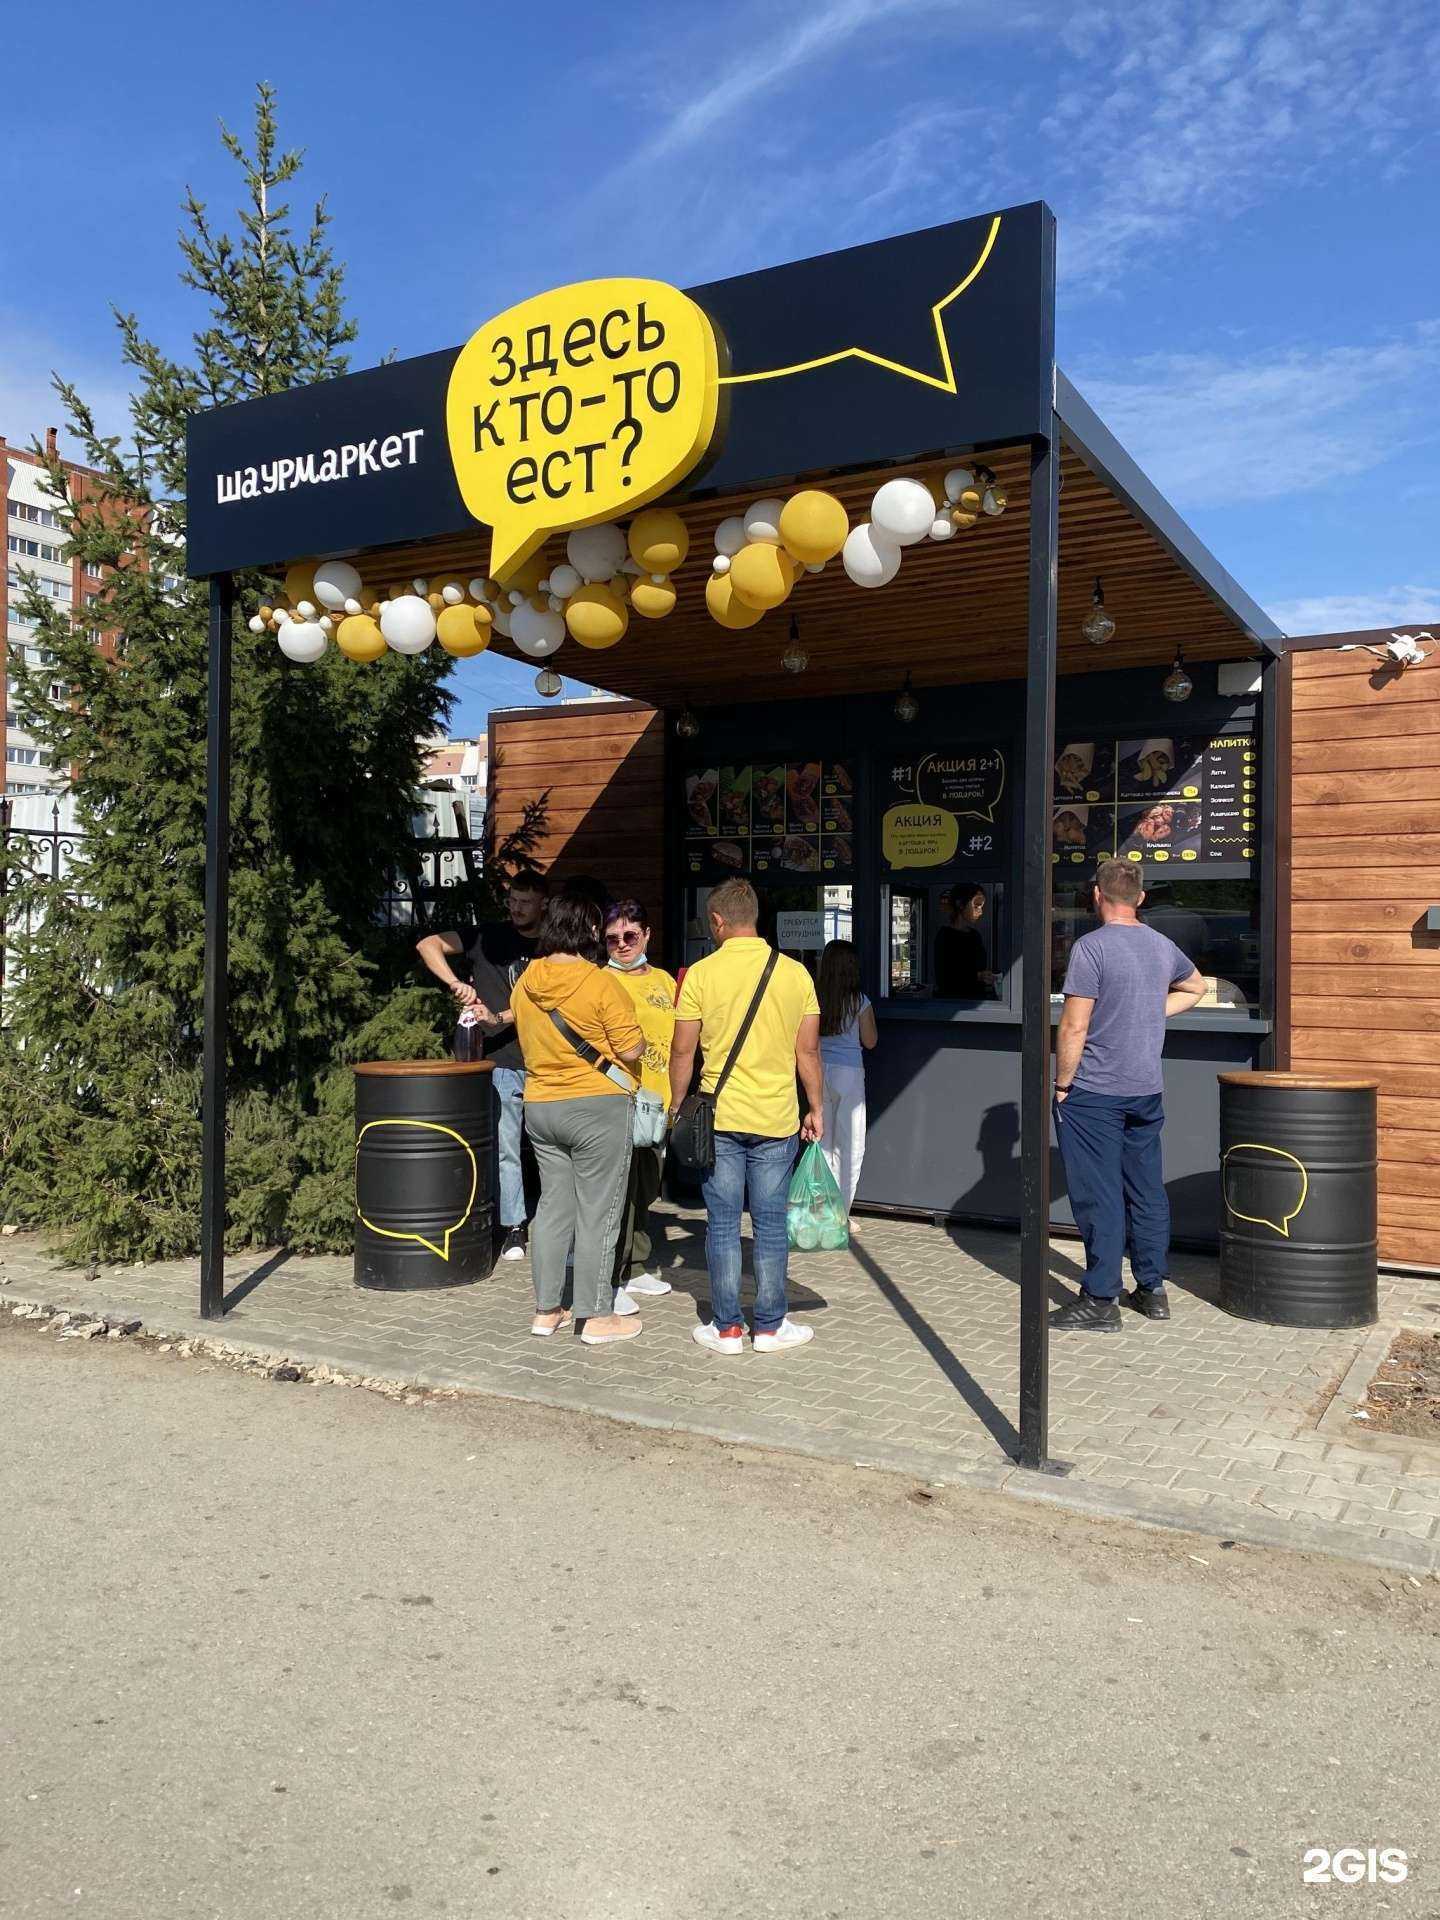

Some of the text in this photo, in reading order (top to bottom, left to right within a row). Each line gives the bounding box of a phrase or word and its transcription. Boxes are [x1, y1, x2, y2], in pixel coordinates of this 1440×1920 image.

[1210, 738, 1256, 749] НАПИТКИ
[927, 758, 1000, 773] АКЦИЯ 2+1
[891, 766, 912, 782] #1
[894, 814, 942, 828] АКЦИЯ
[968, 835, 993, 851] #2
